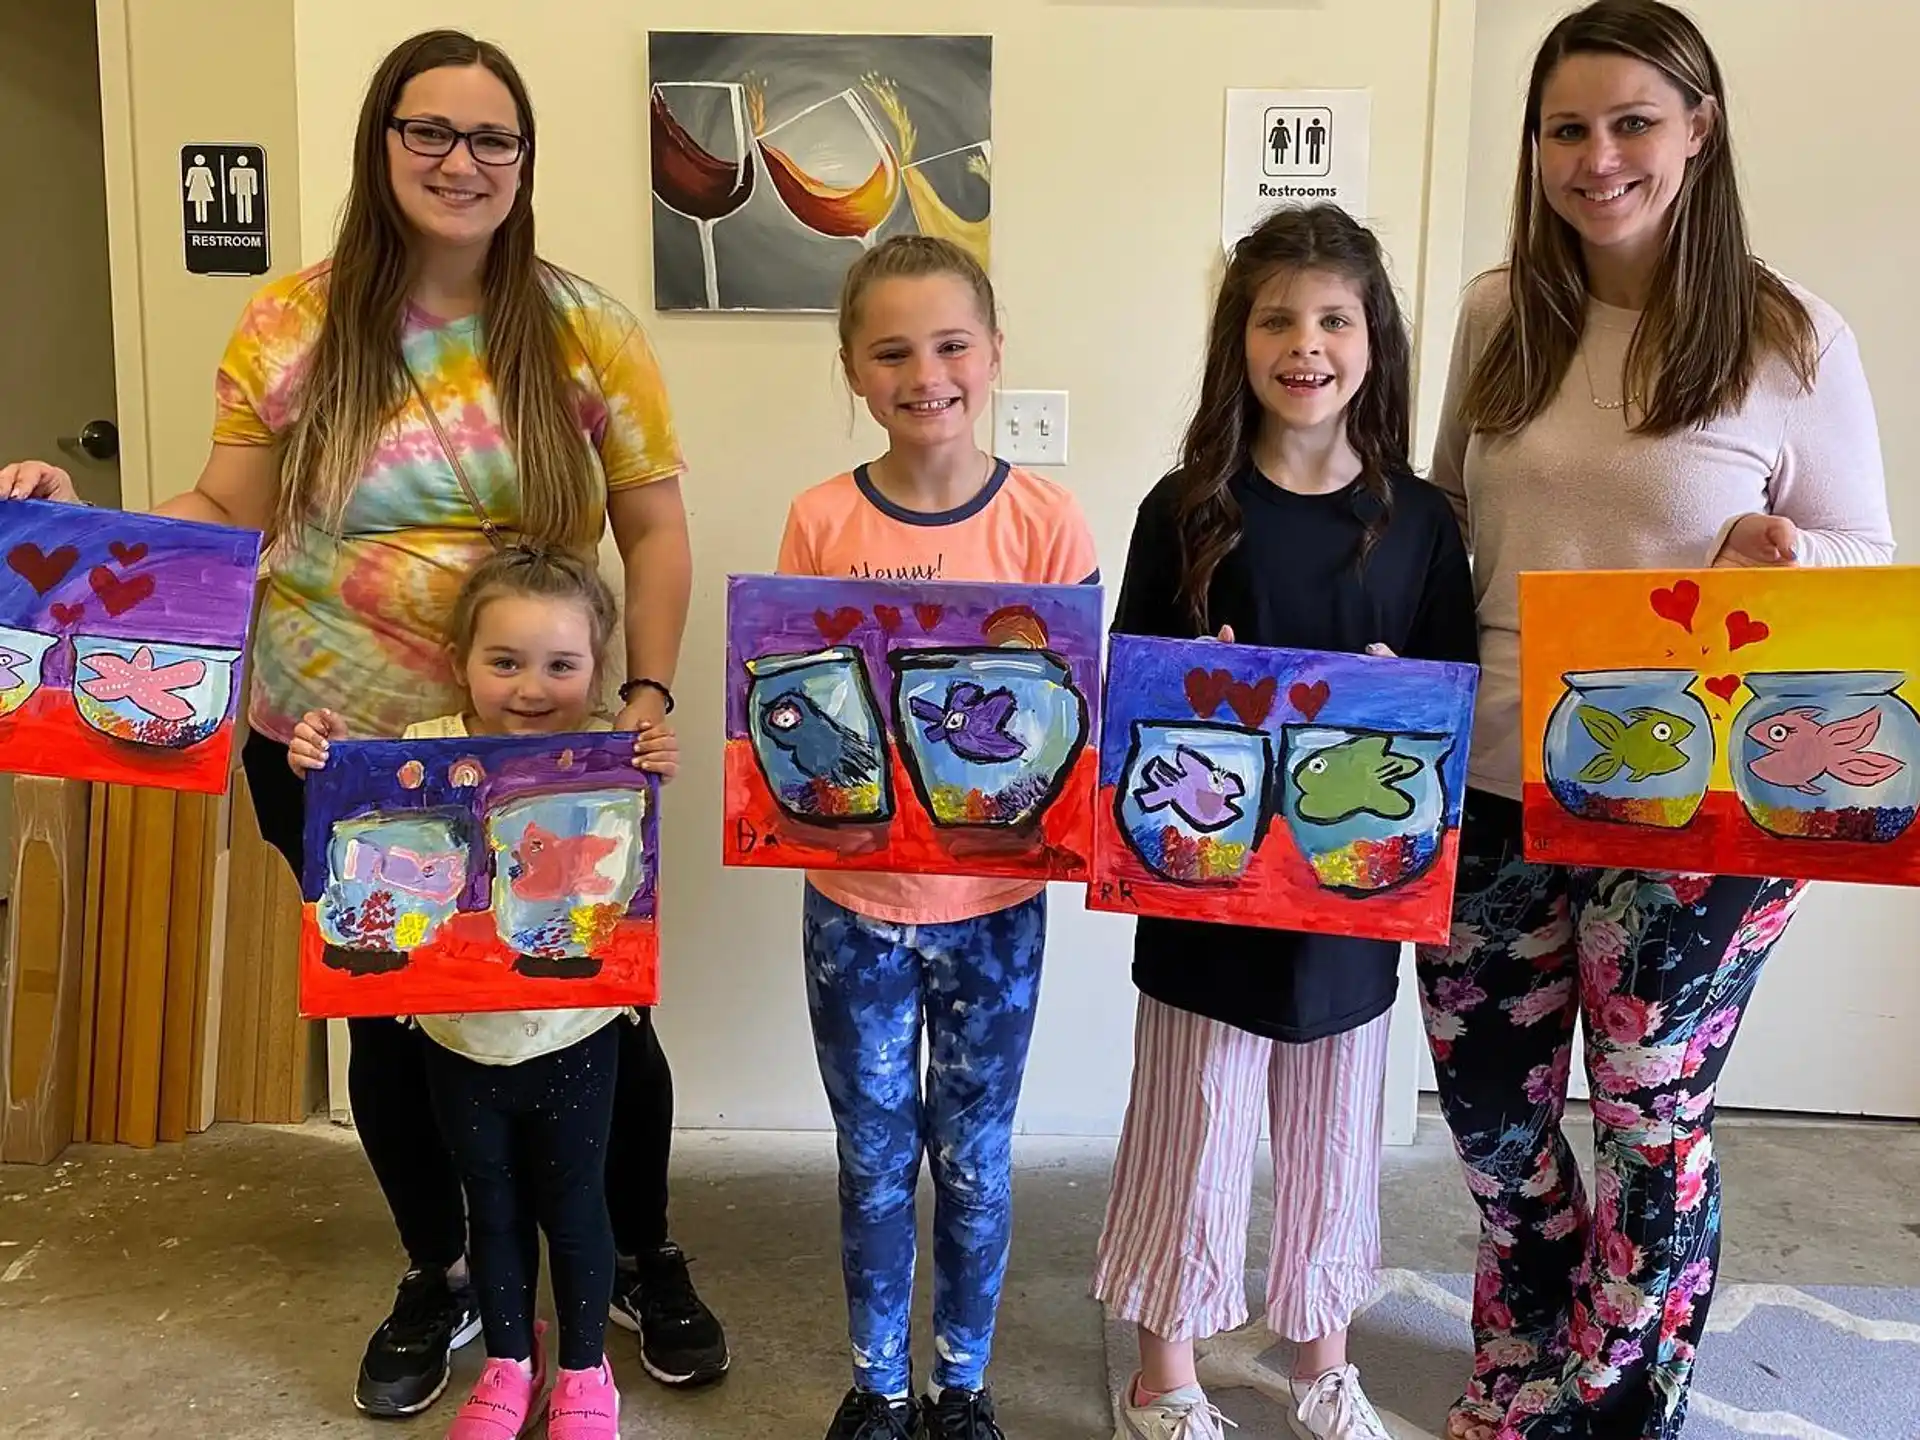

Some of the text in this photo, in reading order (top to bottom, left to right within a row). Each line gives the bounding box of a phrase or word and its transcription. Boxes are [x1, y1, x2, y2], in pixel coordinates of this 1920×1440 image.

[1259, 184, 1337, 197] Restrooms
[192, 235, 262, 247] RESTROOM
[467, 1395, 519, 1417] Champion
[550, 1408, 612, 1420] Champion
